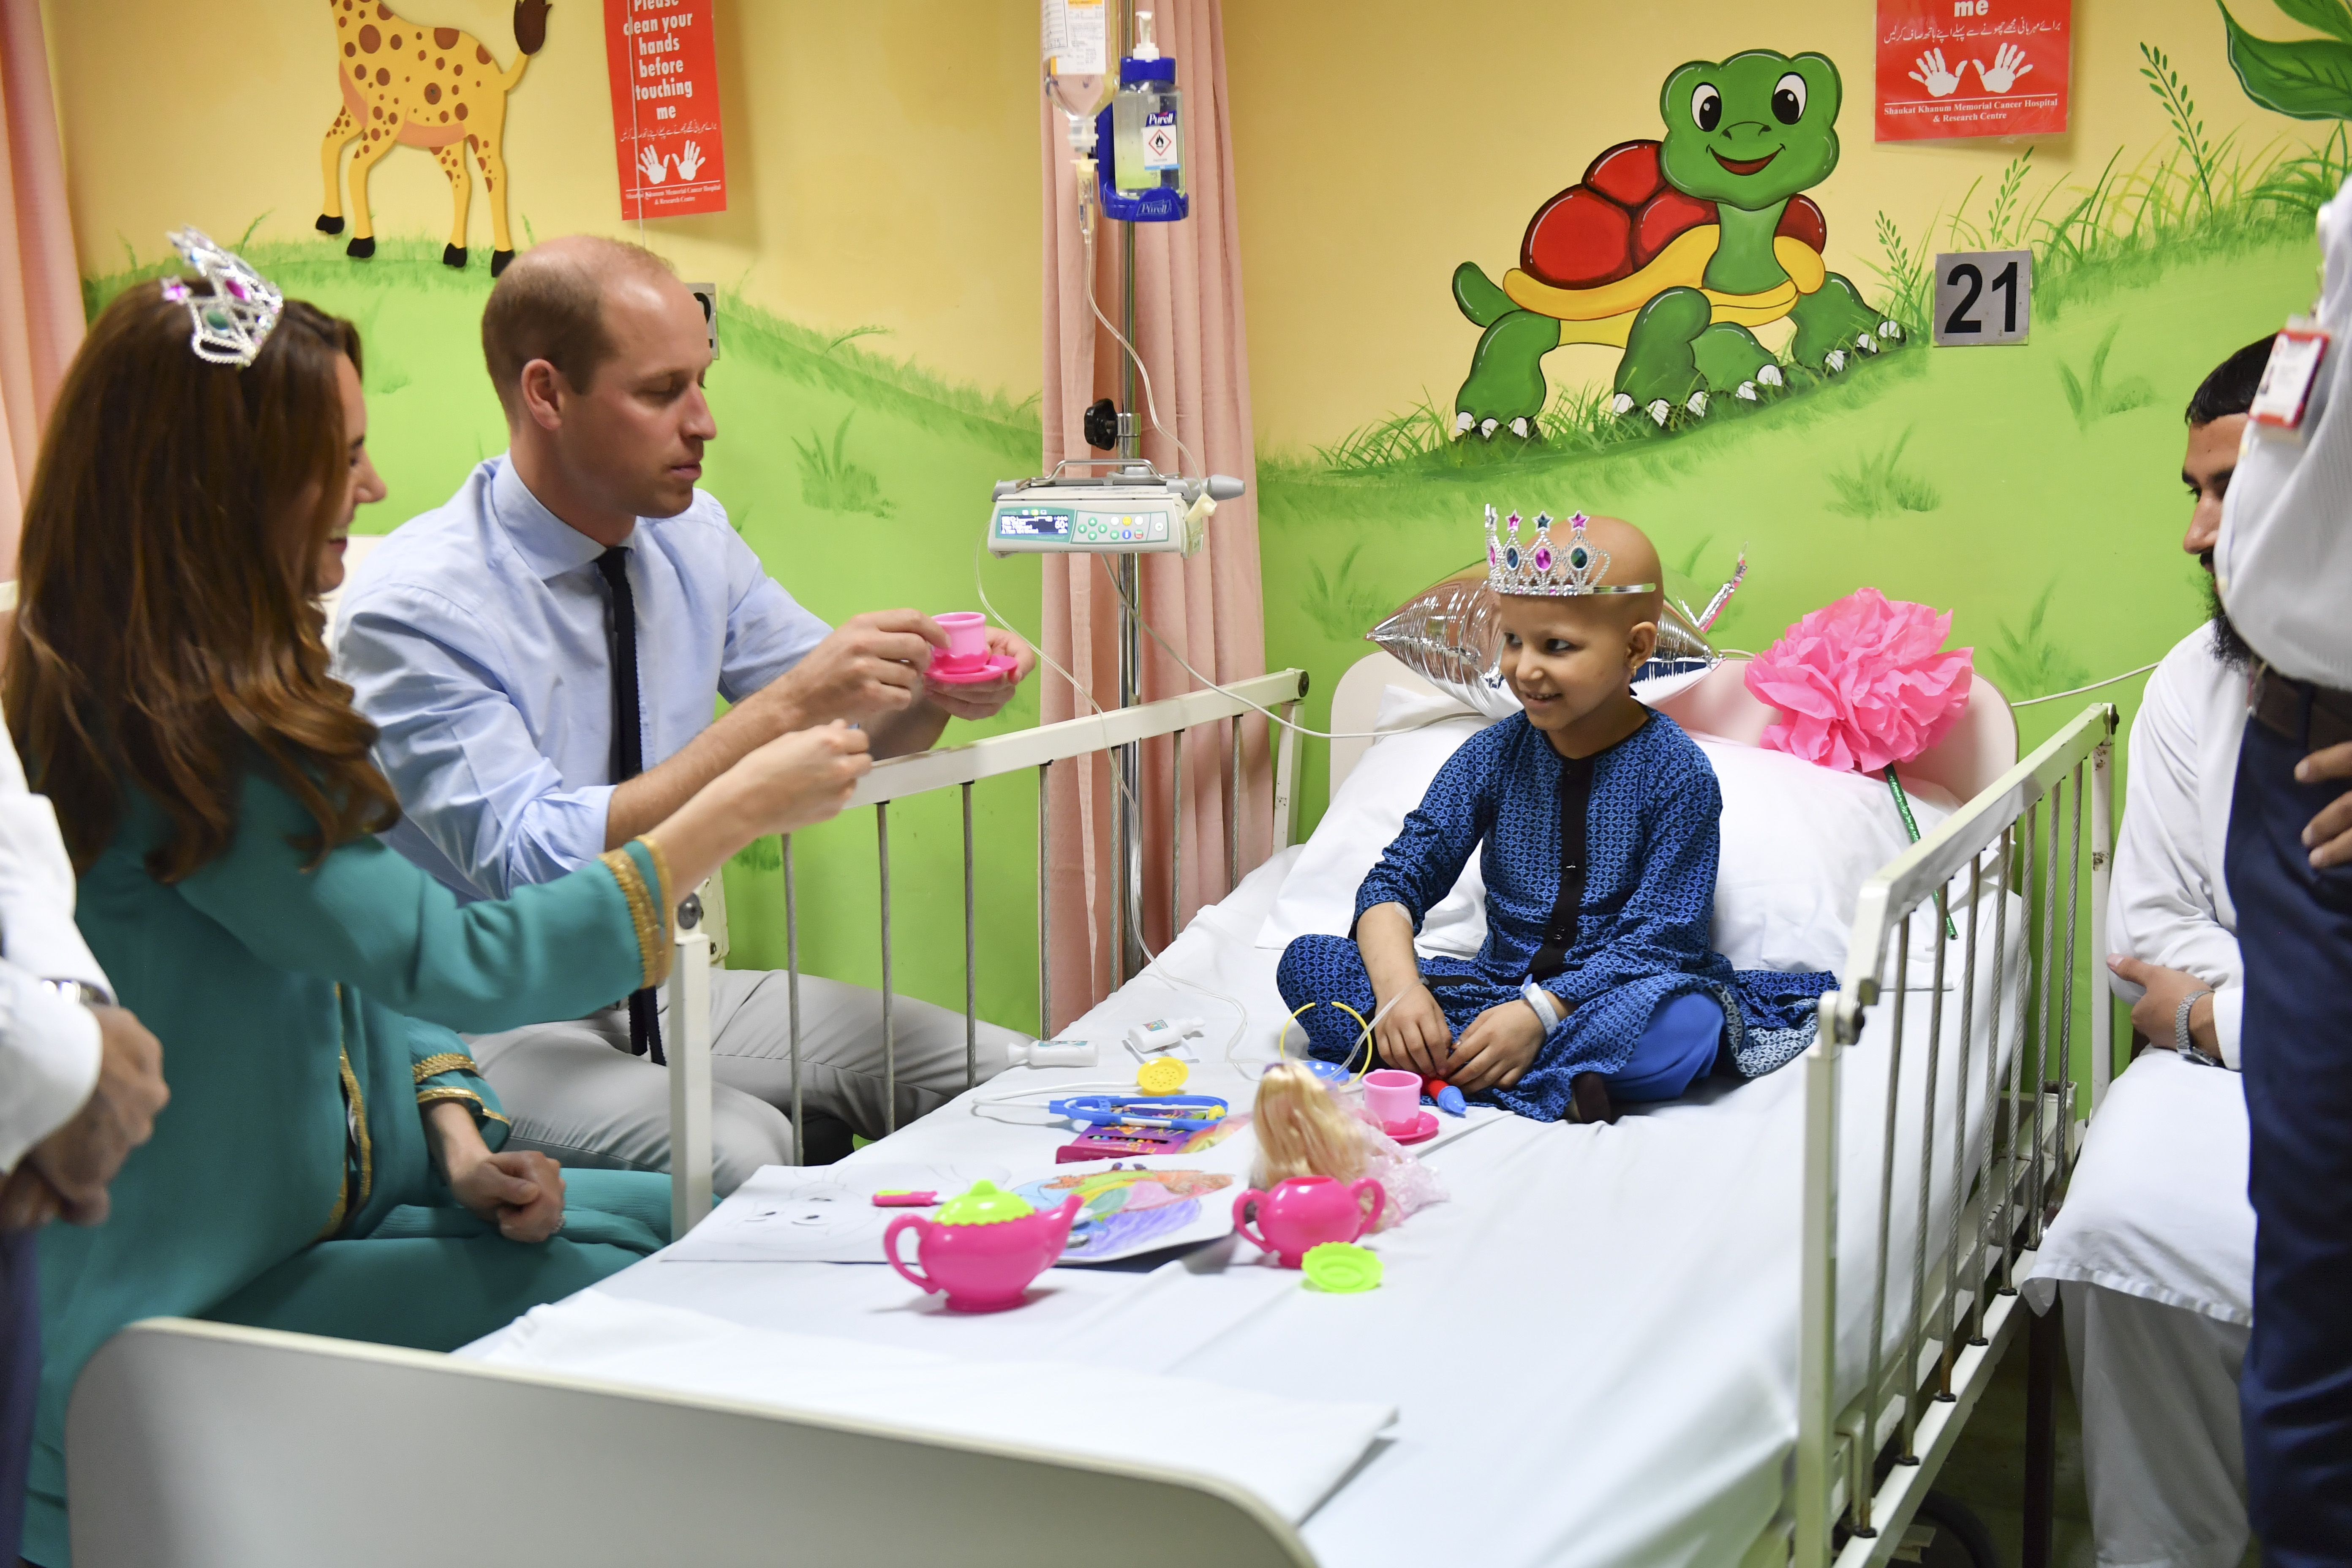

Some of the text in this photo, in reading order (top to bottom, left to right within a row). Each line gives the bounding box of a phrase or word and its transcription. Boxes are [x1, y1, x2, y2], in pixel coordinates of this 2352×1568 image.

[1954, 0, 1989, 16] me
[662, 13, 693, 33] your
[638, 33, 680, 55] hands
[639, 56, 683, 78] before
[635, 77, 693, 101] touching
[656, 106, 676, 120] me
[1884, 98, 2058, 115] Shaukat Khanum Memorial Cancer Hospital
[1149, 113, 1173, 125] Purell
[1943, 113, 1977, 122] Research
[1980, 112, 2007, 120] Centre
[1944, 261, 2017, 333] 21
